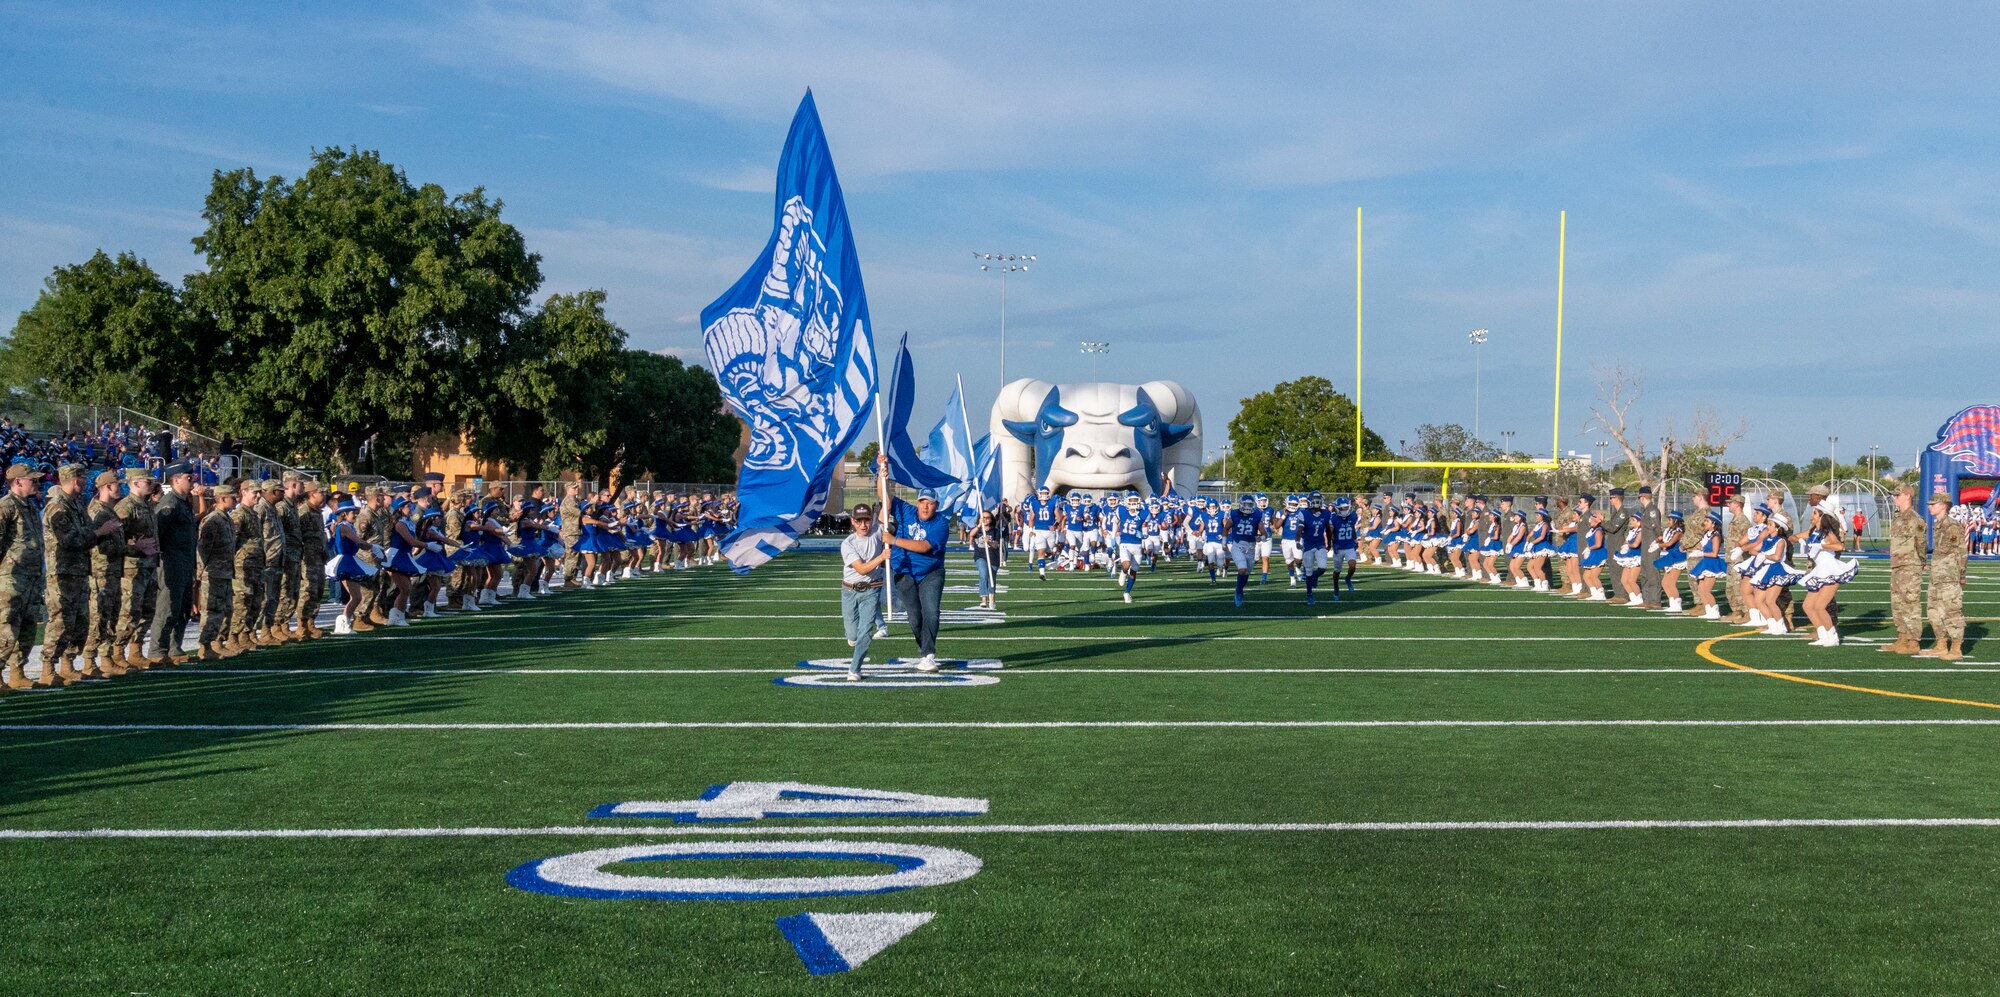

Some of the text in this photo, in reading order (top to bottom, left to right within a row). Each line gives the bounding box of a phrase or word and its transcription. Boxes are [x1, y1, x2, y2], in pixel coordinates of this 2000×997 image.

[1710, 474, 1740, 485] 12:00
[1710, 485, 1736, 505] 25
[1038, 510, 1050, 521] 10
[1070, 514, 1078, 525] 7
[1122, 521, 1137, 535] 15
[1147, 521, 1158, 533] 34
[1207, 521, 1219, 533] 17
[1236, 523, 1254, 535] 32
[1289, 520, 1297, 531] 5
[1313, 525, 1320, 537] 1
[1338, 527, 1353, 540] 20
